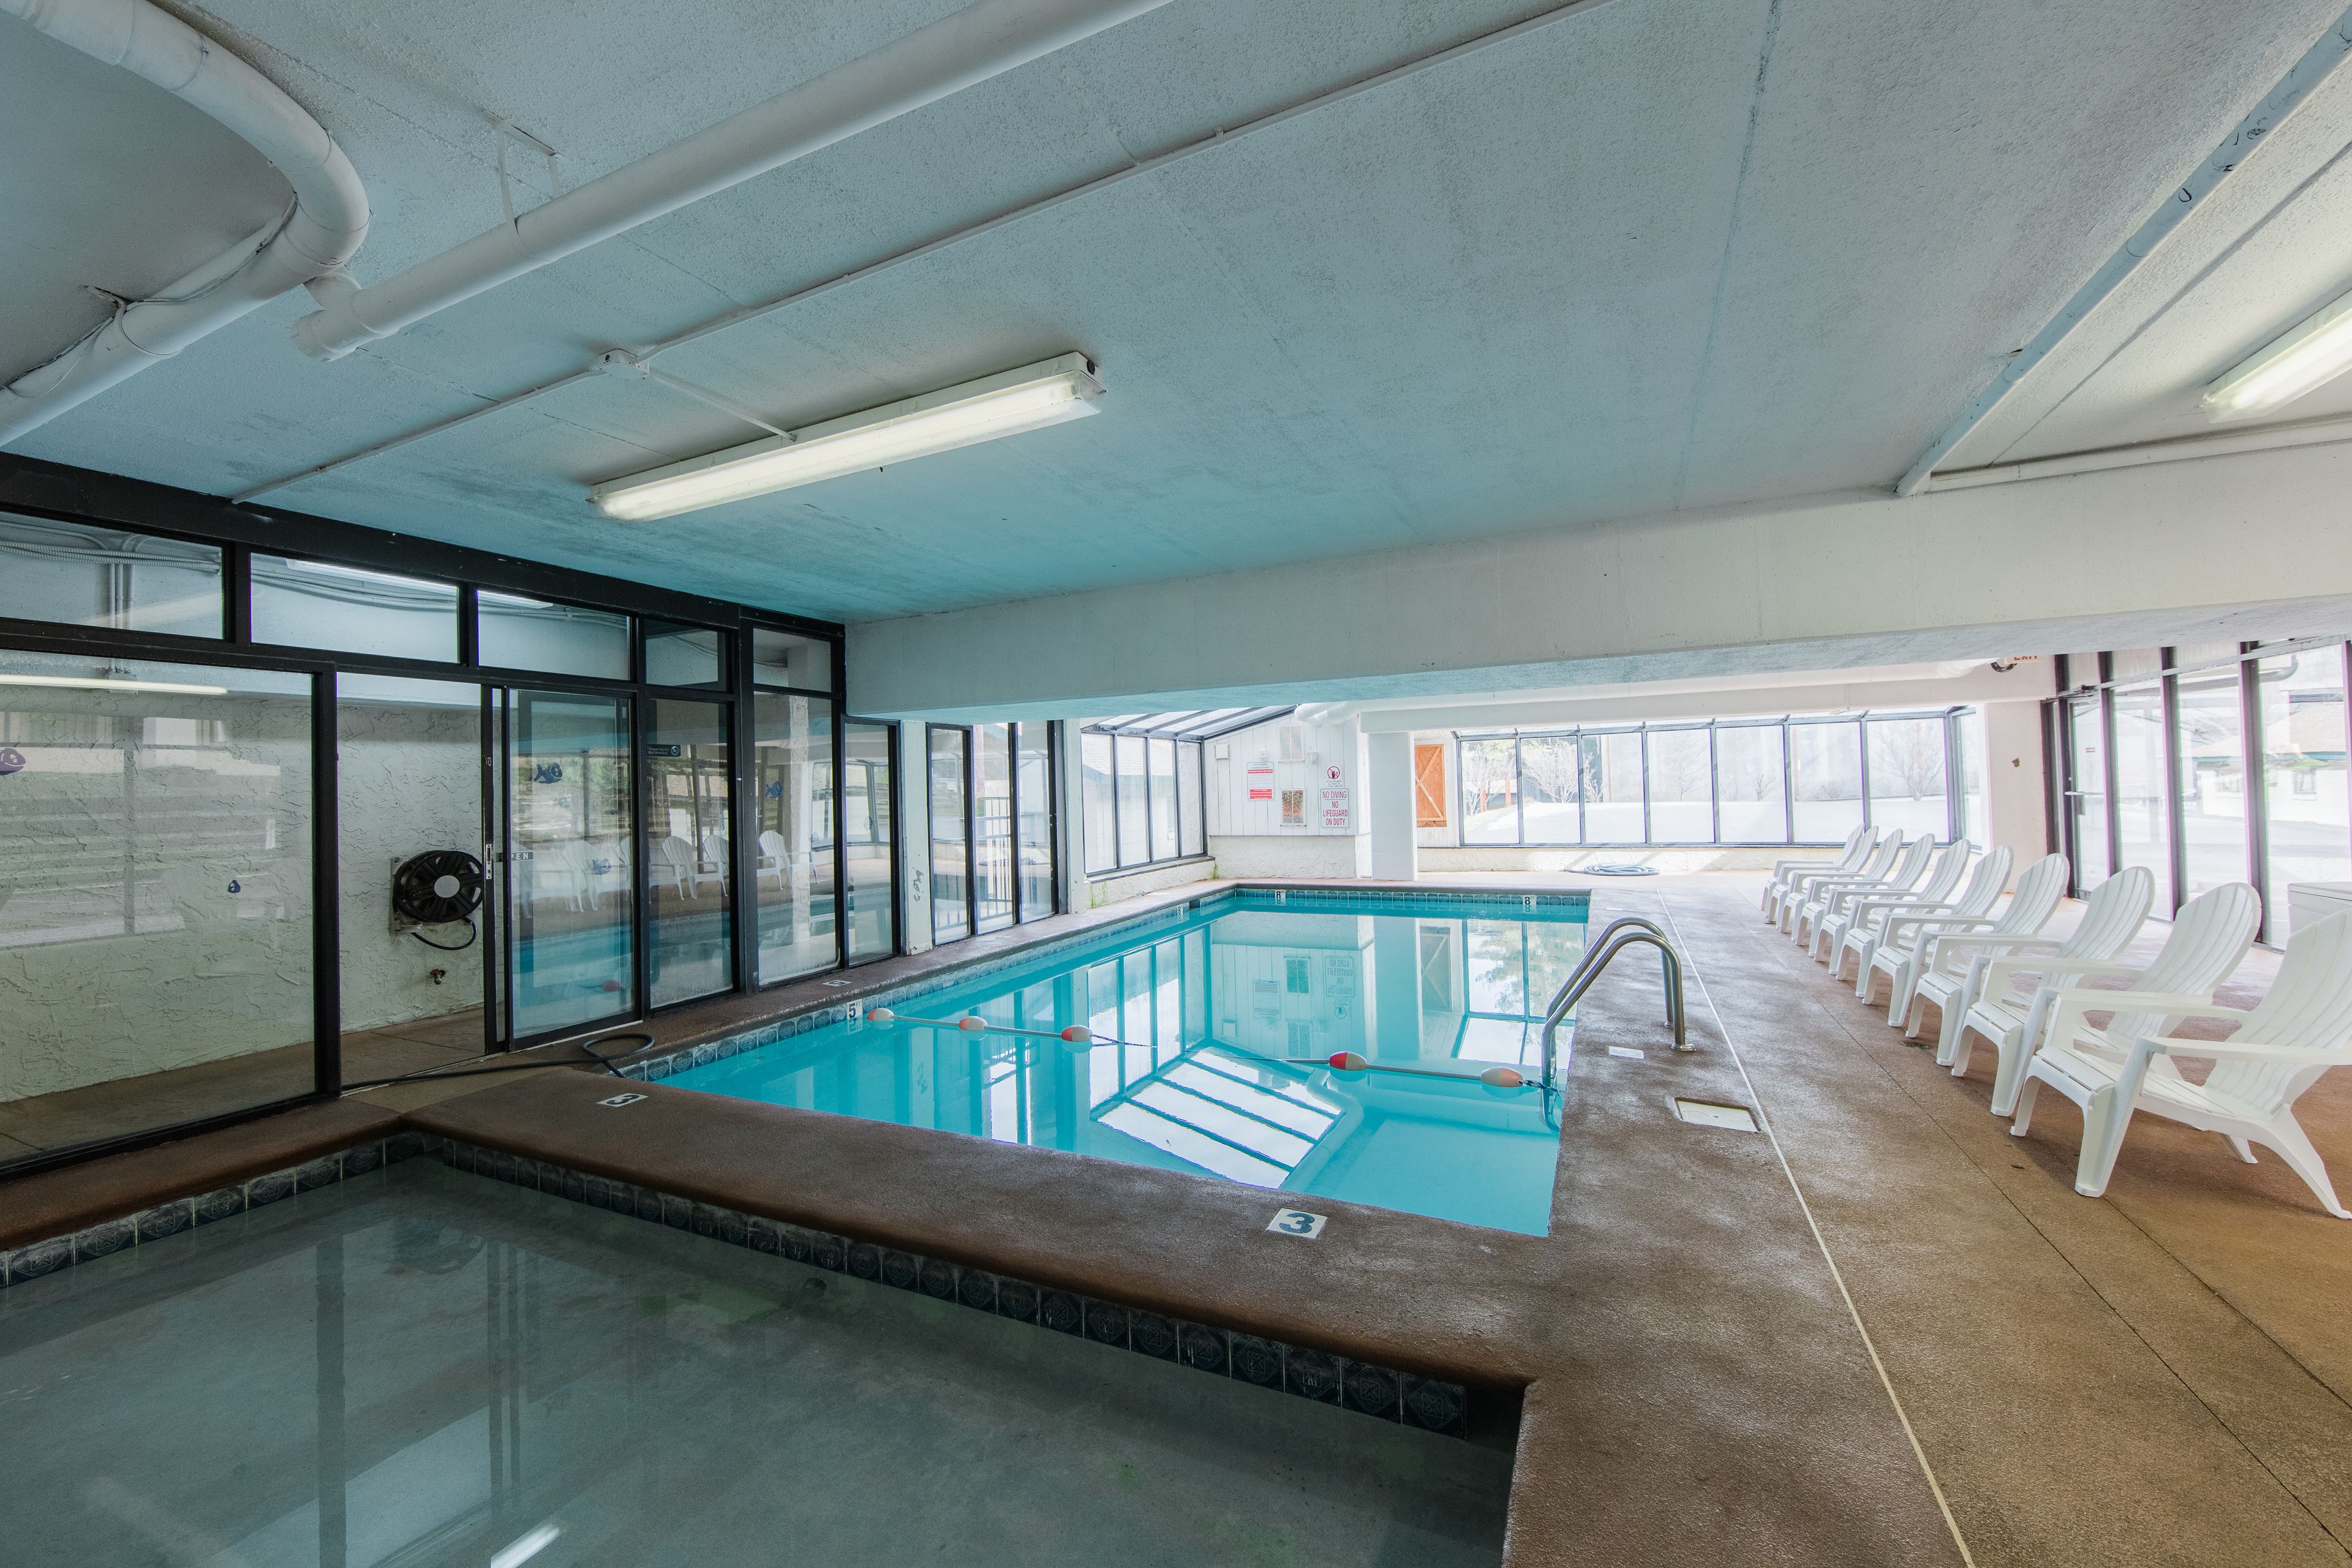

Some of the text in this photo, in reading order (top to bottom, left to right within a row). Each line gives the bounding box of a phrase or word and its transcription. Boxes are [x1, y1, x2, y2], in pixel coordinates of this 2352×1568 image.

[1178, 906, 1181, 914] 8
[849, 1003, 856, 1019] 5
[606, 1095, 640, 1105] 3
[1278, 1212, 1316, 1234] 3
